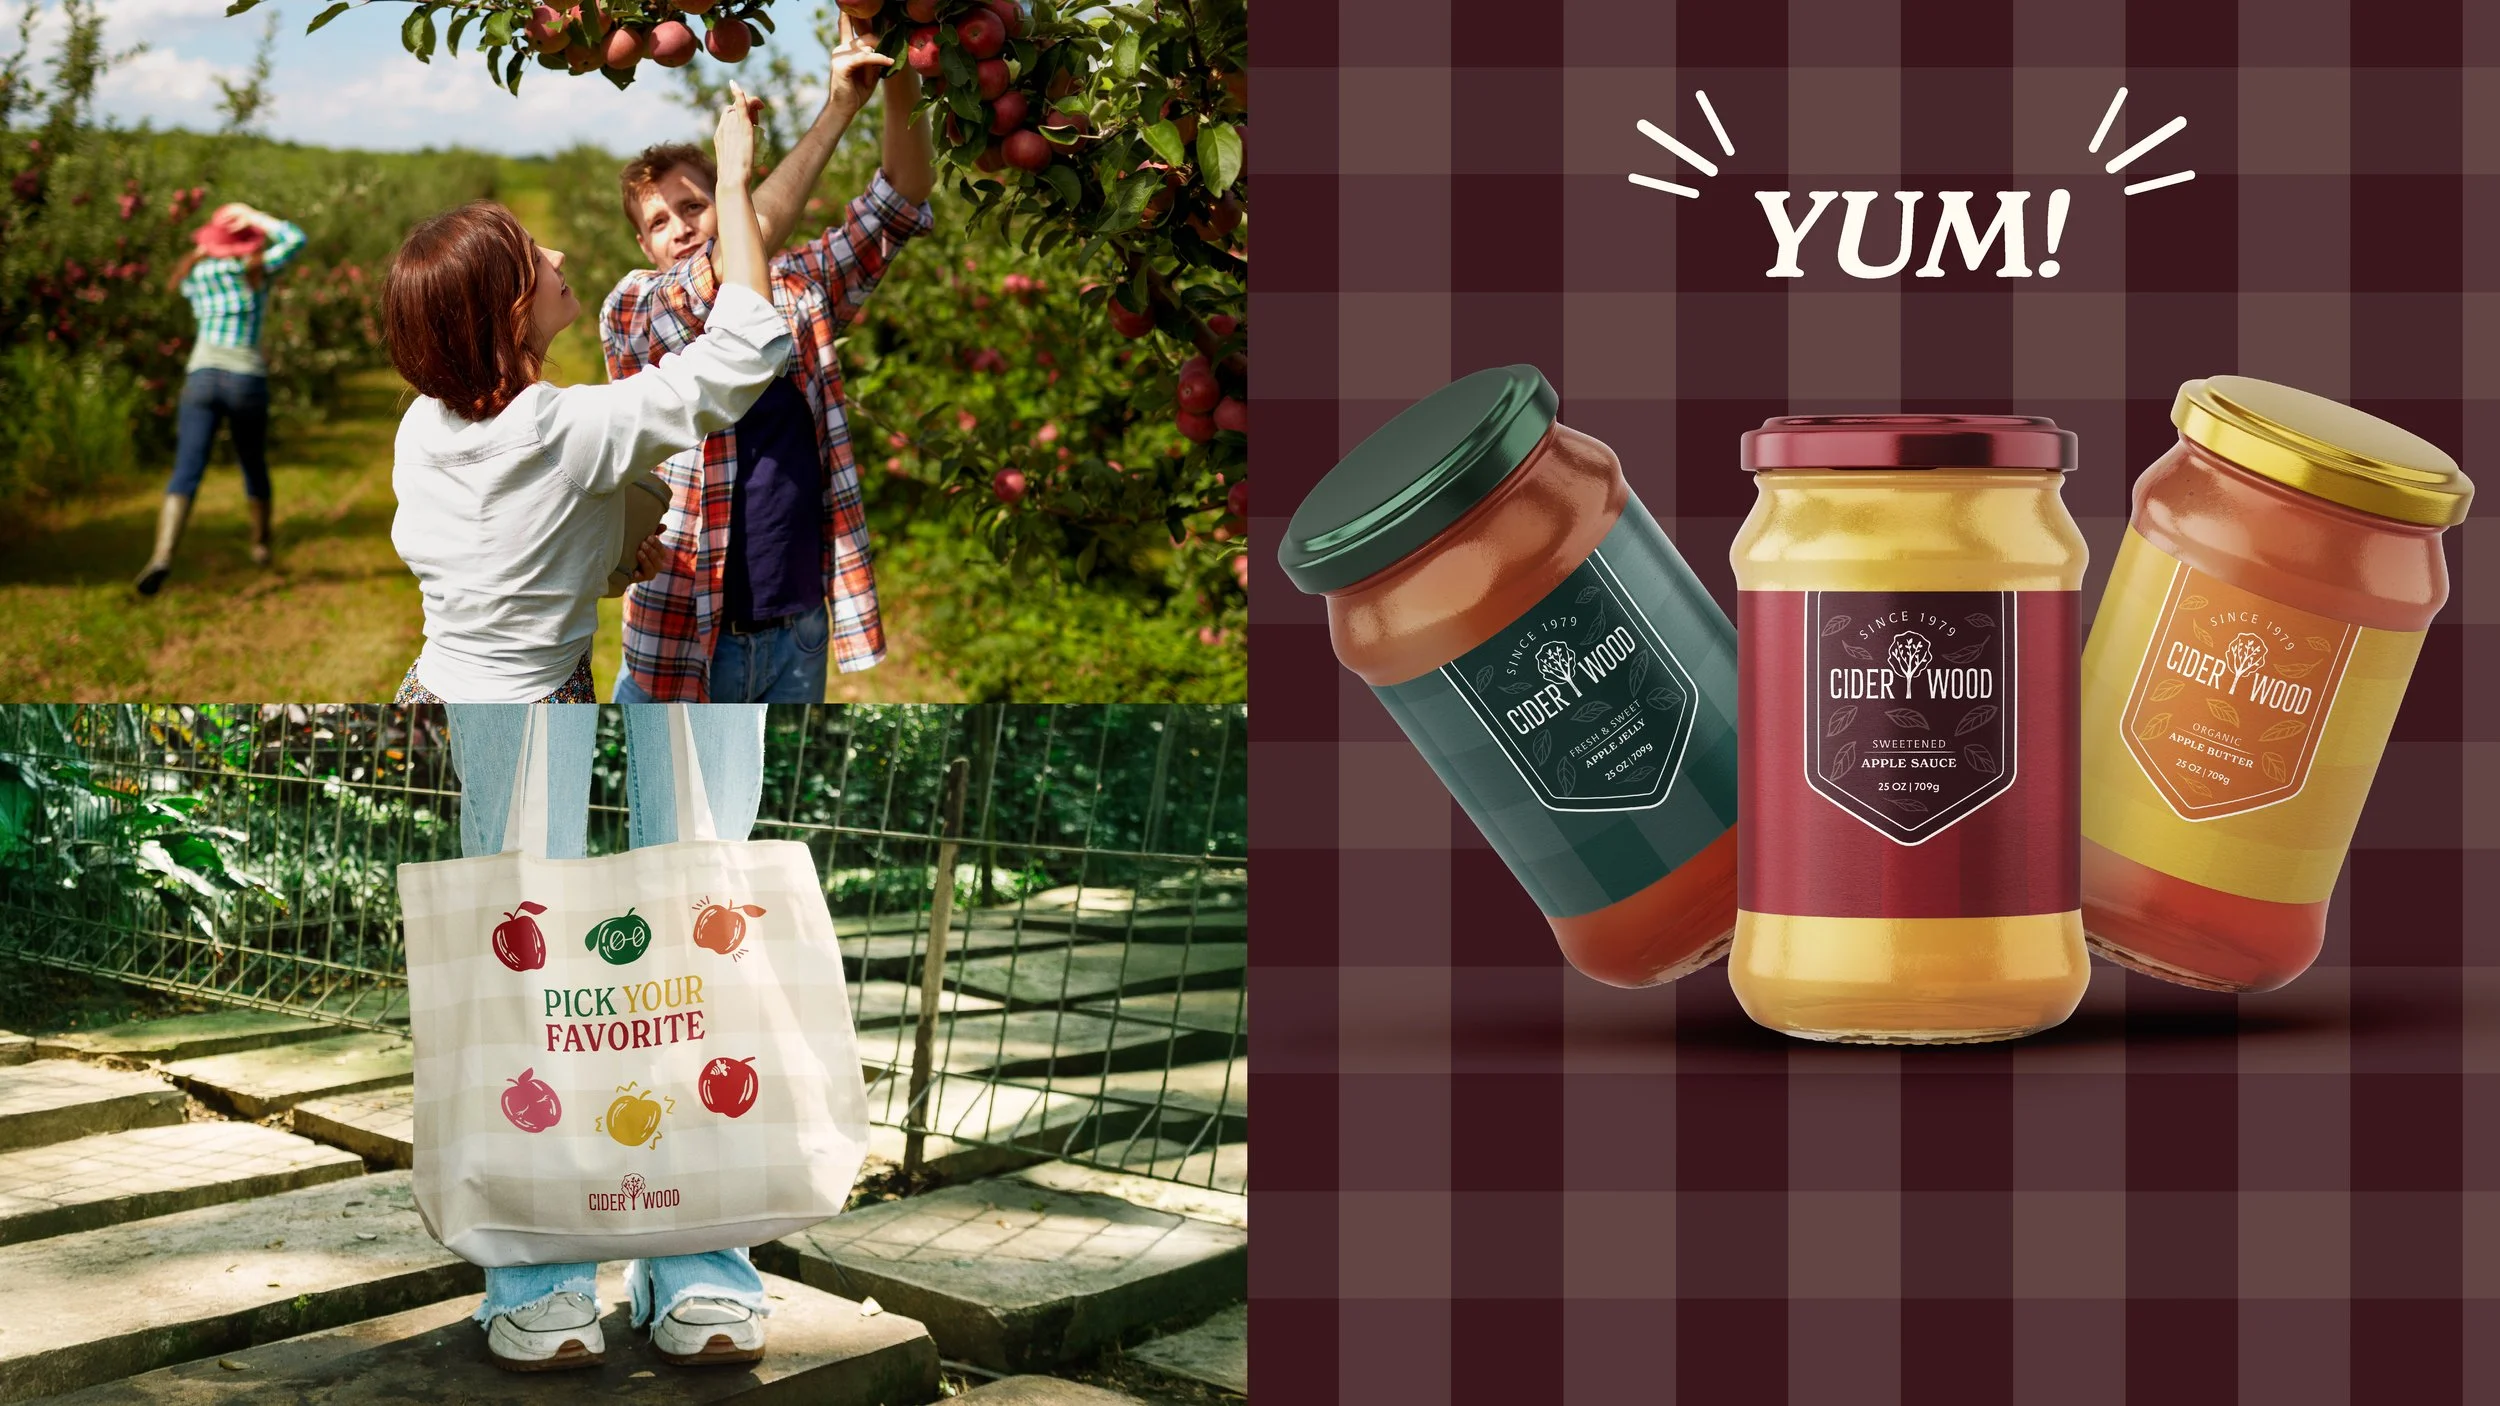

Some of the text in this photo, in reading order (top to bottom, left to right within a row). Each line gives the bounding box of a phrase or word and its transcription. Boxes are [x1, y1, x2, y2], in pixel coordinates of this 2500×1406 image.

[1859, 610, 1957, 640] SINCE 1979
[2210, 611, 2295, 651] SINCE 1979
[1506, 616, 1577, 676] SINCE 1979
[1506, 626, 1636, 735] CIDER WOOD
[1830, 668, 1993, 700] CIDER WOOD
[2166, 641, 2312, 715] CIDER WOOD
[1569, 699, 1641, 758] FRESH & SWEET
[1584, 718, 1646, 769] APPLE JELLY
[1872, 739, 1946, 749] SWEETENED
[2192, 722, 2242, 747] ORGANIC
[1604, 770, 1617, 781] 25
[1616, 760, 1630, 773] OZ
[1632, 742, 1653, 762] 709g
[1861, 758, 1957, 769] APPLE SAUCE
[2168, 732, 2254, 768] APPLE BUTTER
[1878, 782, 1890, 791] 25
[1892, 782, 1907, 791] OZ
[1914, 782, 1940, 793] 709g
[2175, 758, 2188, 768] 25
[2187, 763, 2203, 775] OZ
[2206, 769, 2230, 786] 709g
[544, 975, 704, 1018] PICK YOUR
[545, 1010, 706, 1052] FAVORITE
[588, 1188, 680, 1212] CIDER WOOD
